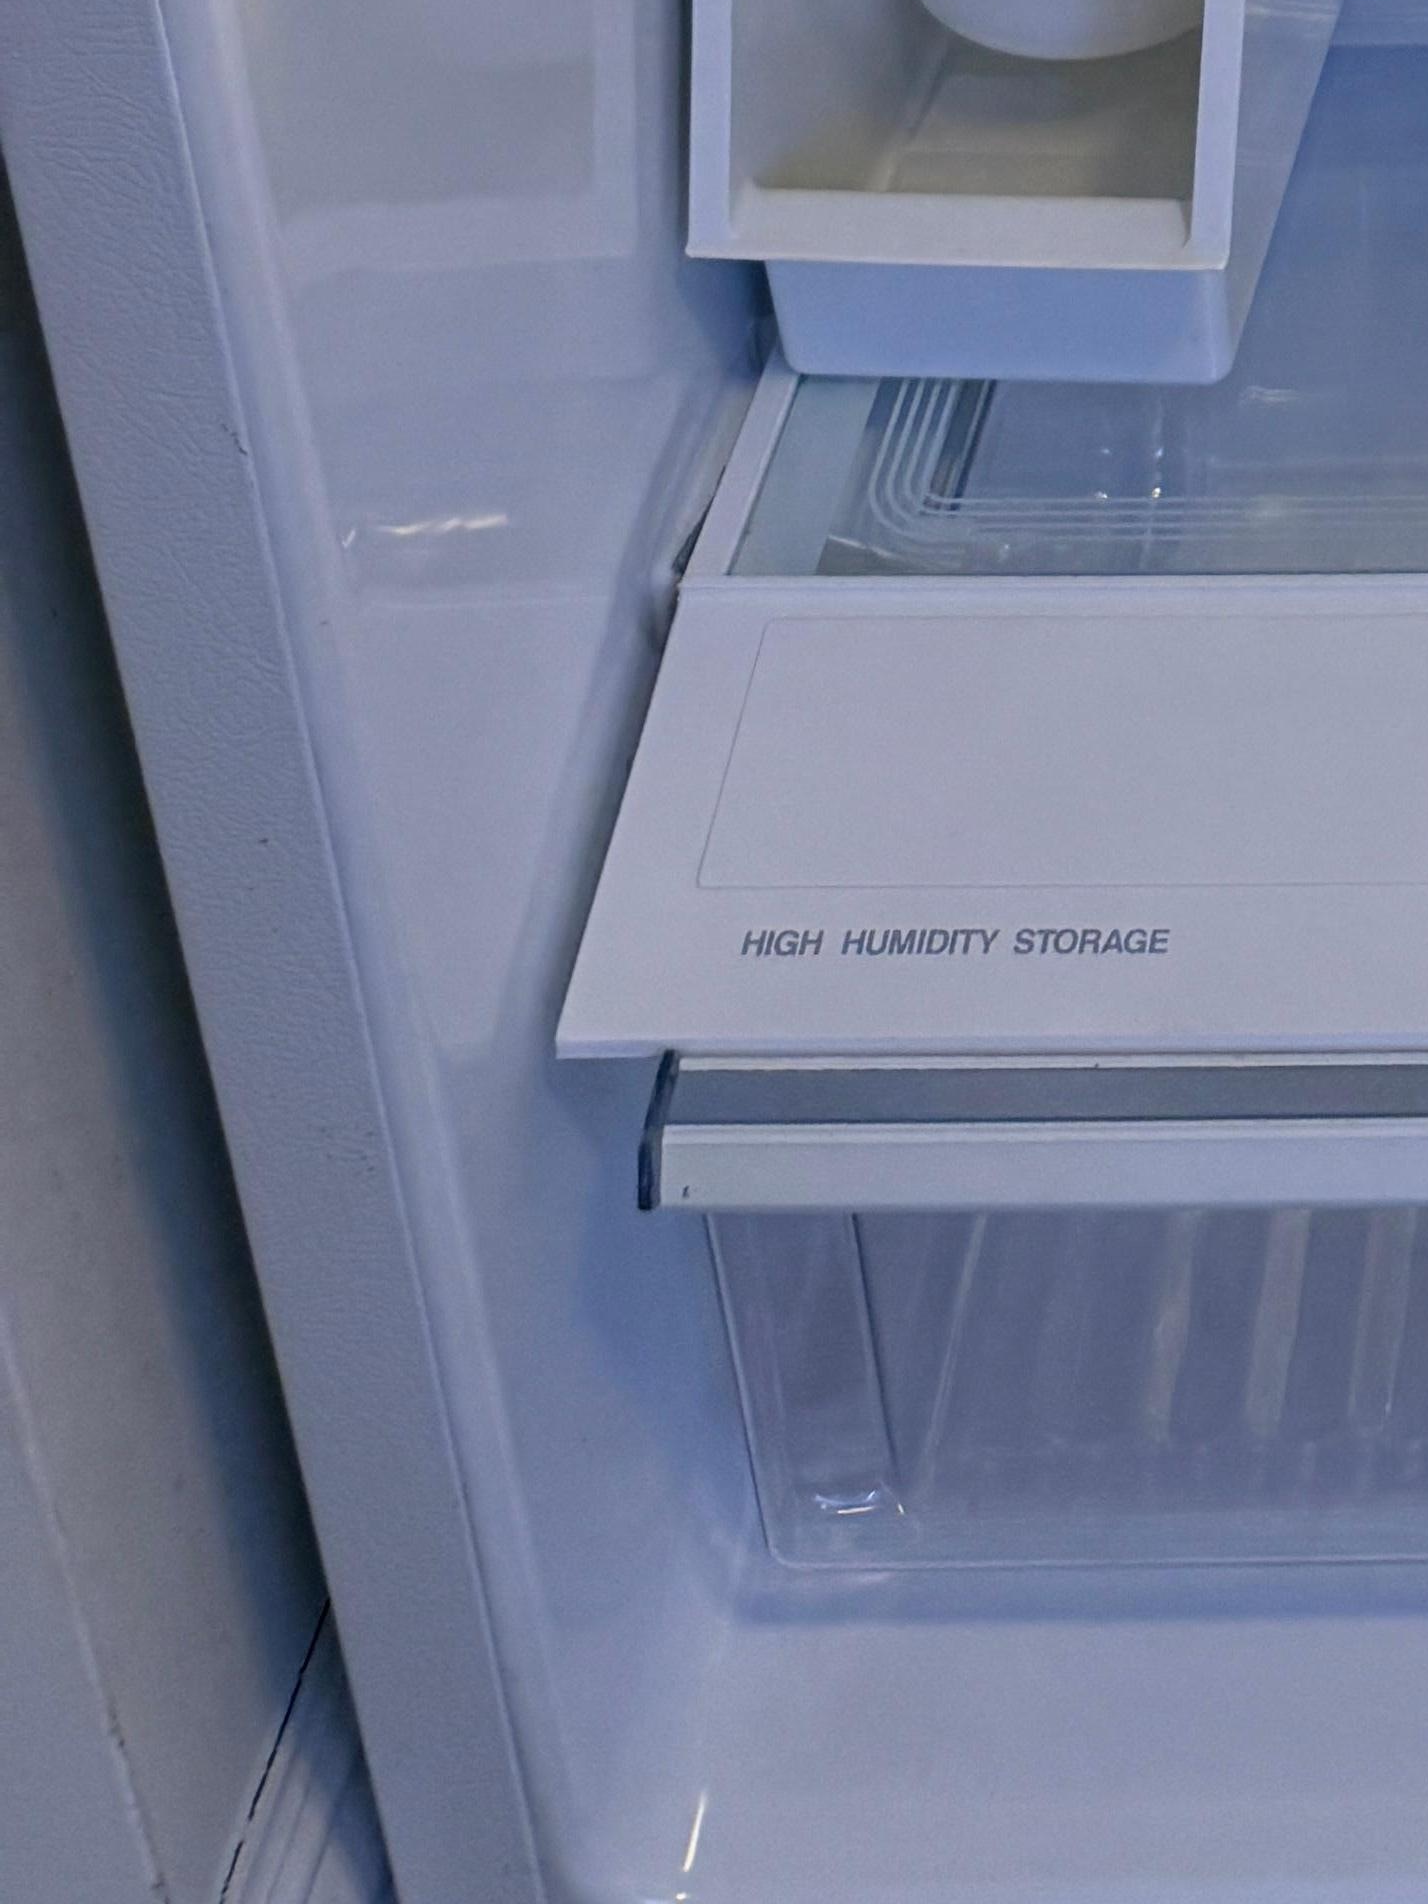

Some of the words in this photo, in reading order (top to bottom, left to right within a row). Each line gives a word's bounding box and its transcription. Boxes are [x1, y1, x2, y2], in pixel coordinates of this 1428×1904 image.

[741, 929, 825, 956] HIGH
[840, 928, 1000, 956] HUMIDITY
[1013, 928, 1171, 955] STORAGE
